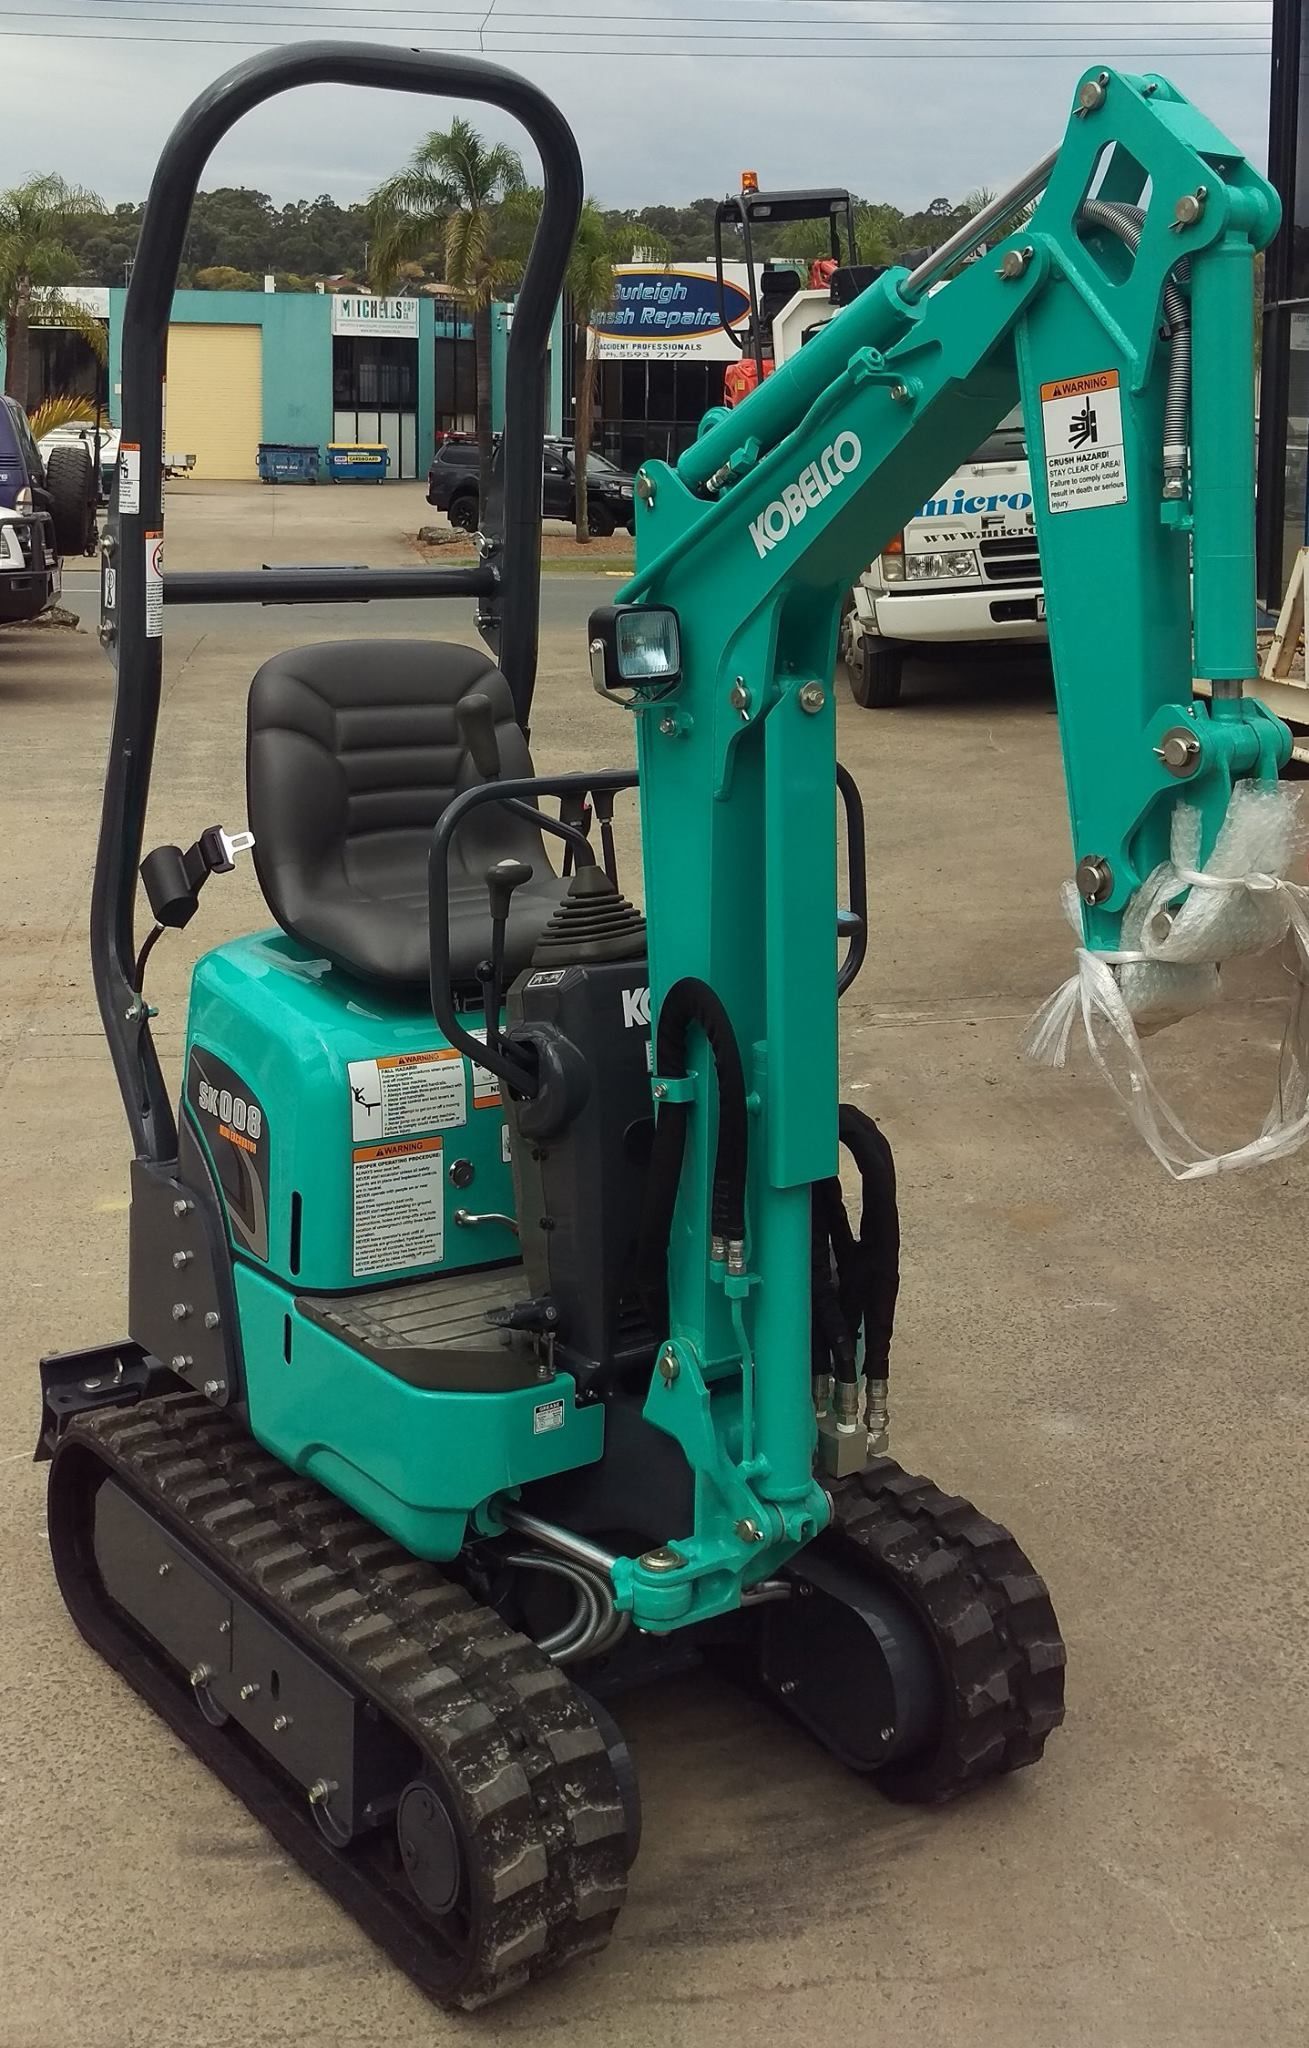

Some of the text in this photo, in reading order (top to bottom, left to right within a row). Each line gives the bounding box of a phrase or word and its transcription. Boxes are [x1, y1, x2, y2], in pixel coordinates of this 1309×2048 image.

[640, 307, 722, 328] Repairs
[600, 343, 703, 351] ACCIDENT PROFESSIONALS
[1062, 376, 1108, 393] WARNING
[1049, 451, 1110, 467] CRUSH HAZARD!
[1049, 468, 1066, 477] STAY
[1067, 464, 1090, 475] CLEAR
[1091, 462, 1099, 471] OF
[1050, 478, 1070, 487] Failure
[1079, 474, 1101, 484] comply
[1102, 470, 1120, 480] could
[748, 431, 862, 560] KOBELCO
[1051, 480, 1125, 498] result in death or serious
[406, 1053, 439, 1063] WARNING
[198, 1080, 262, 1139] SK008
[385, 1141, 423, 1155] WARNING
